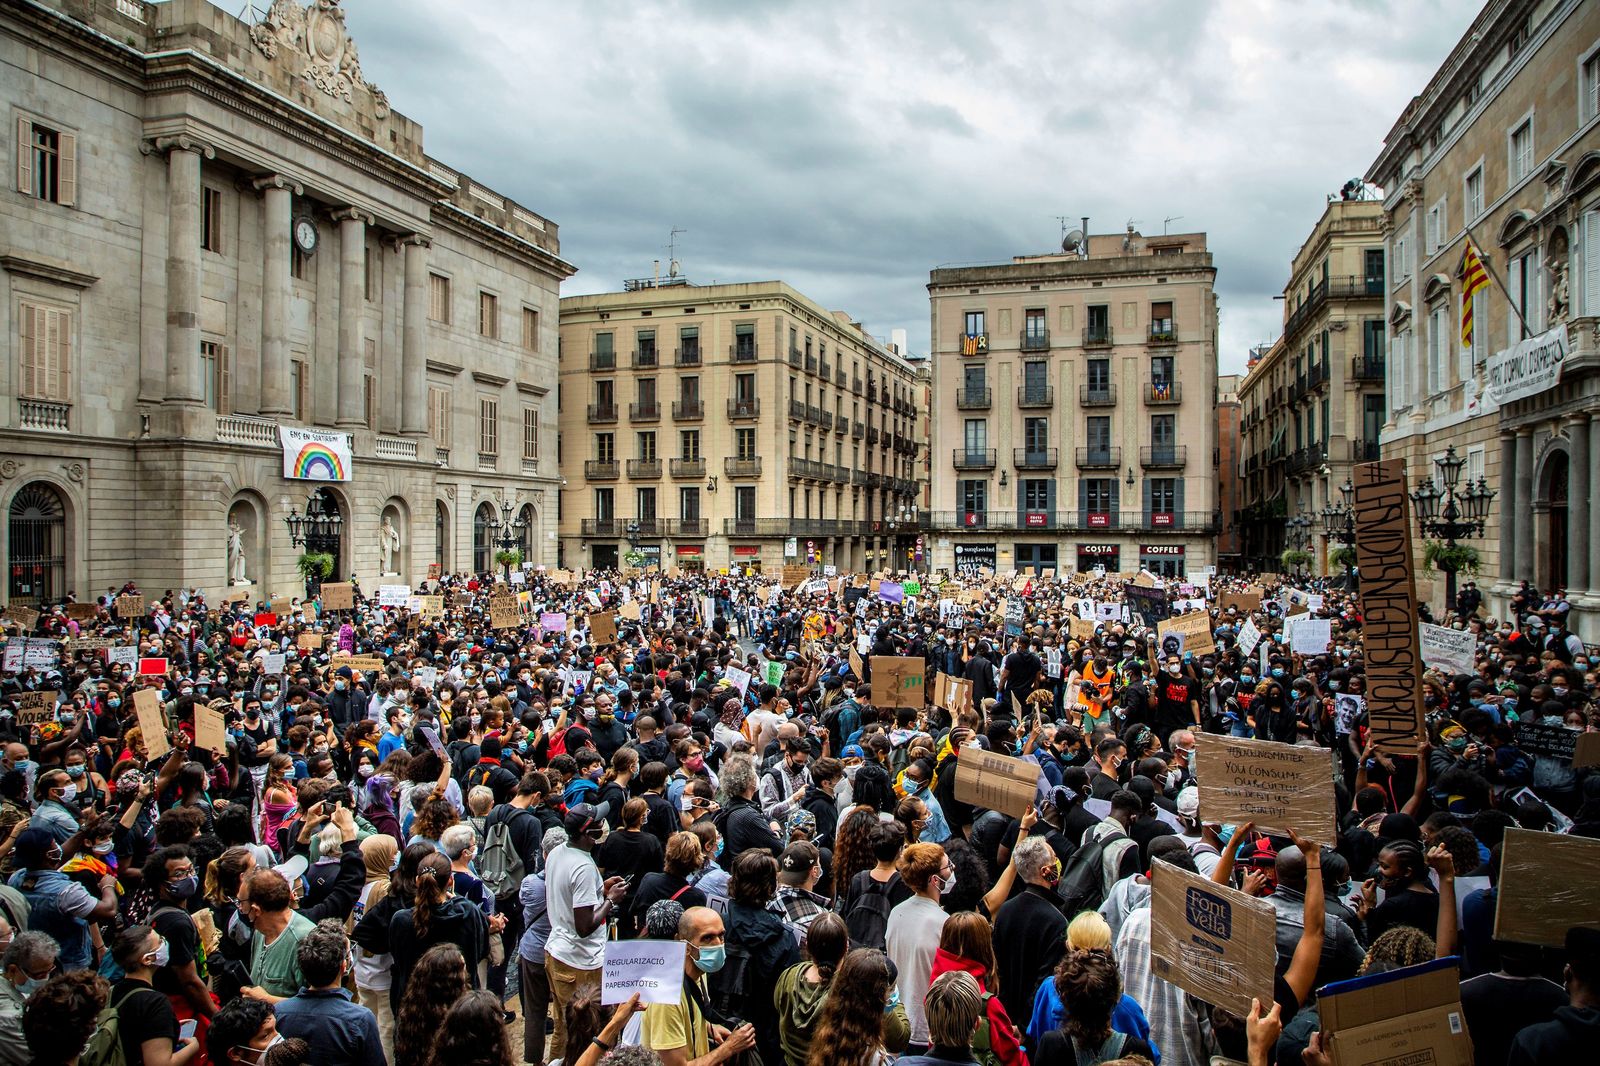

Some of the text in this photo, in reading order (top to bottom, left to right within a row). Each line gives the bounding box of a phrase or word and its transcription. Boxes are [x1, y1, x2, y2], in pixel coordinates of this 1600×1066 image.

[1146, 546, 1179, 554] COFFEE
[20, 701, 53, 711] SILENCE IS
[18, 712, 54, 724] VIOLENCE
[1224, 761, 1301, 781] YOU CONSUME
[1234, 777, 1260, 787] OUR
[1274, 795, 1290, 805] US
[1191, 890, 1226, 919] Font
[1191, 906, 1226, 935] Vella
[607, 957, 664, 966] REGULARIZACIÓ
[606, 980, 658, 989] PAPERSXTOTES
